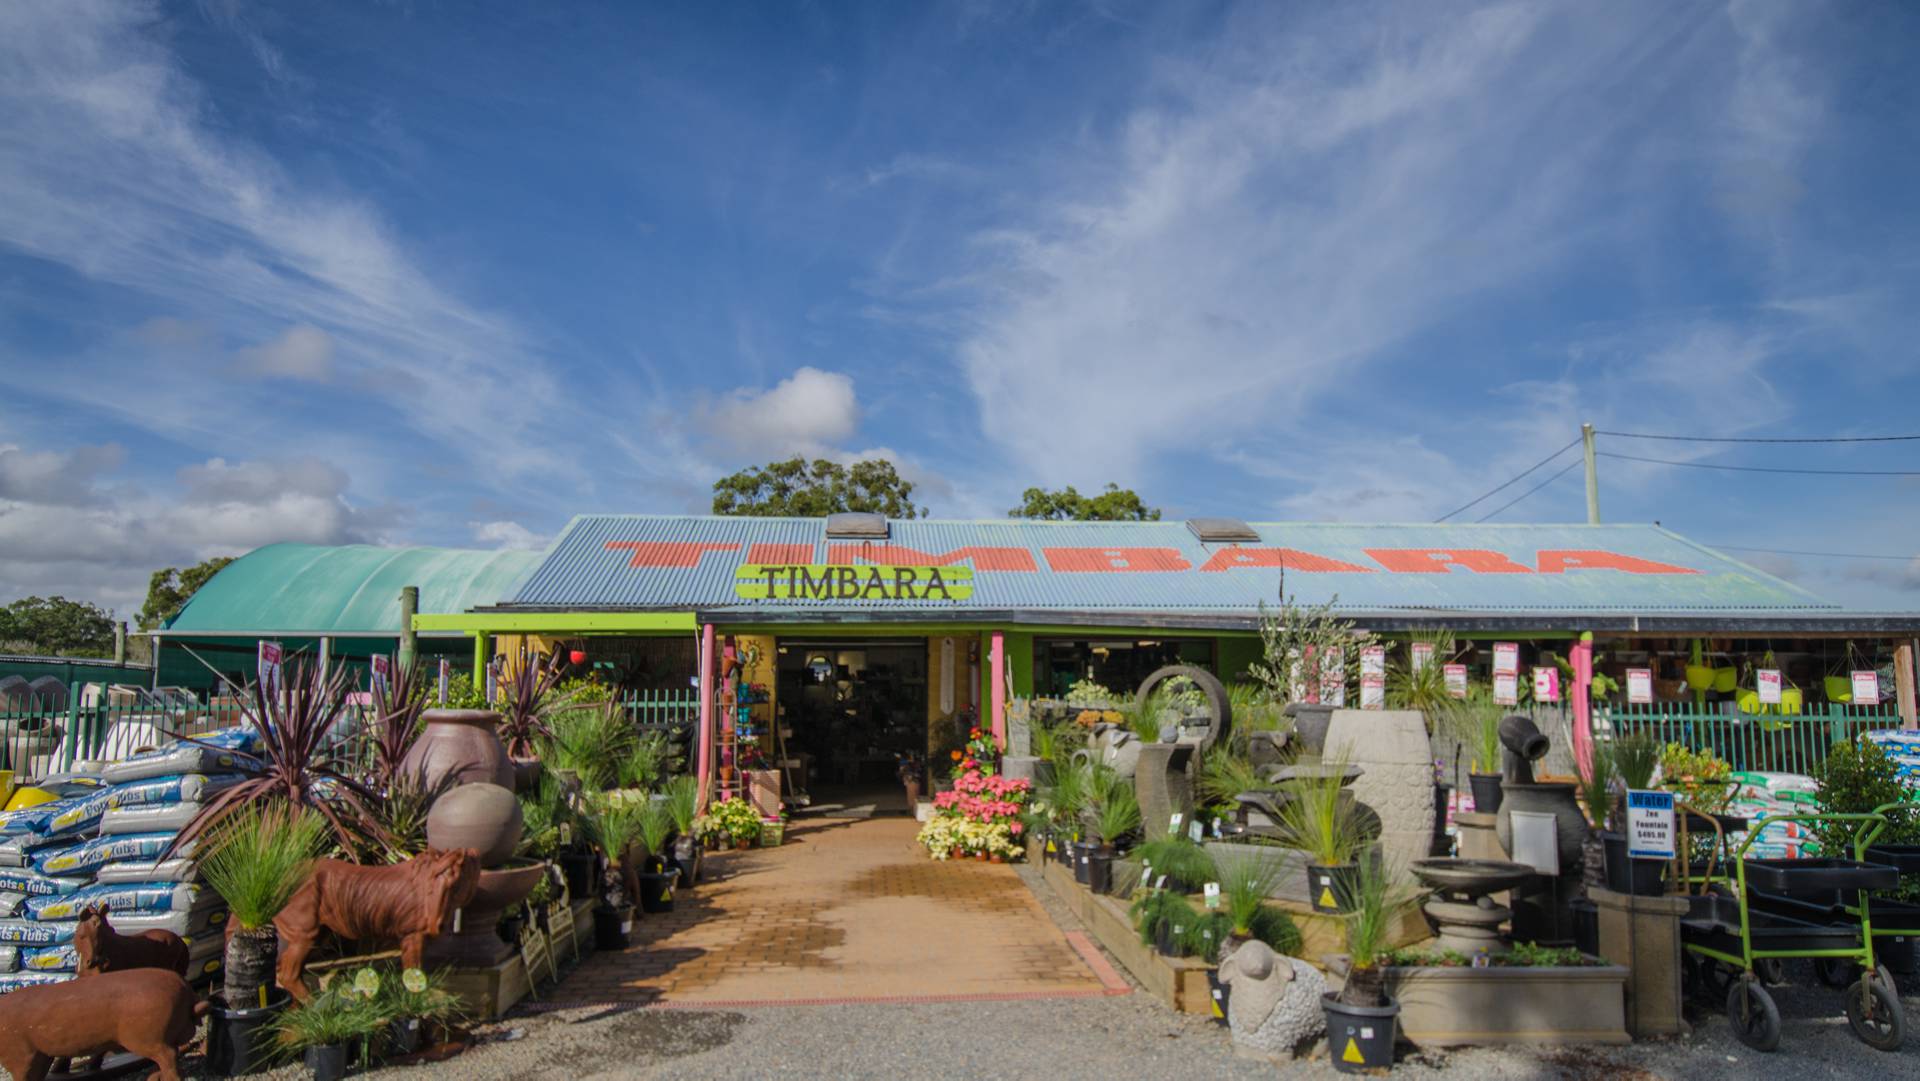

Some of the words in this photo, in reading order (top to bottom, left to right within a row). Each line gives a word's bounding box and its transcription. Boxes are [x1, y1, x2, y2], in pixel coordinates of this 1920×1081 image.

[603, 541, 1705, 575] TIMBARA
[760, 566, 952, 600] TIMBARA
[1631, 793, 1670, 807] Water
[1635, 820, 1669, 829] Fountain
[0, 879, 17, 890] ots
[26, 879, 53, 895] Tubs
[106, 896, 132, 909] Tubs
[20, 926, 49, 942] Tubs
